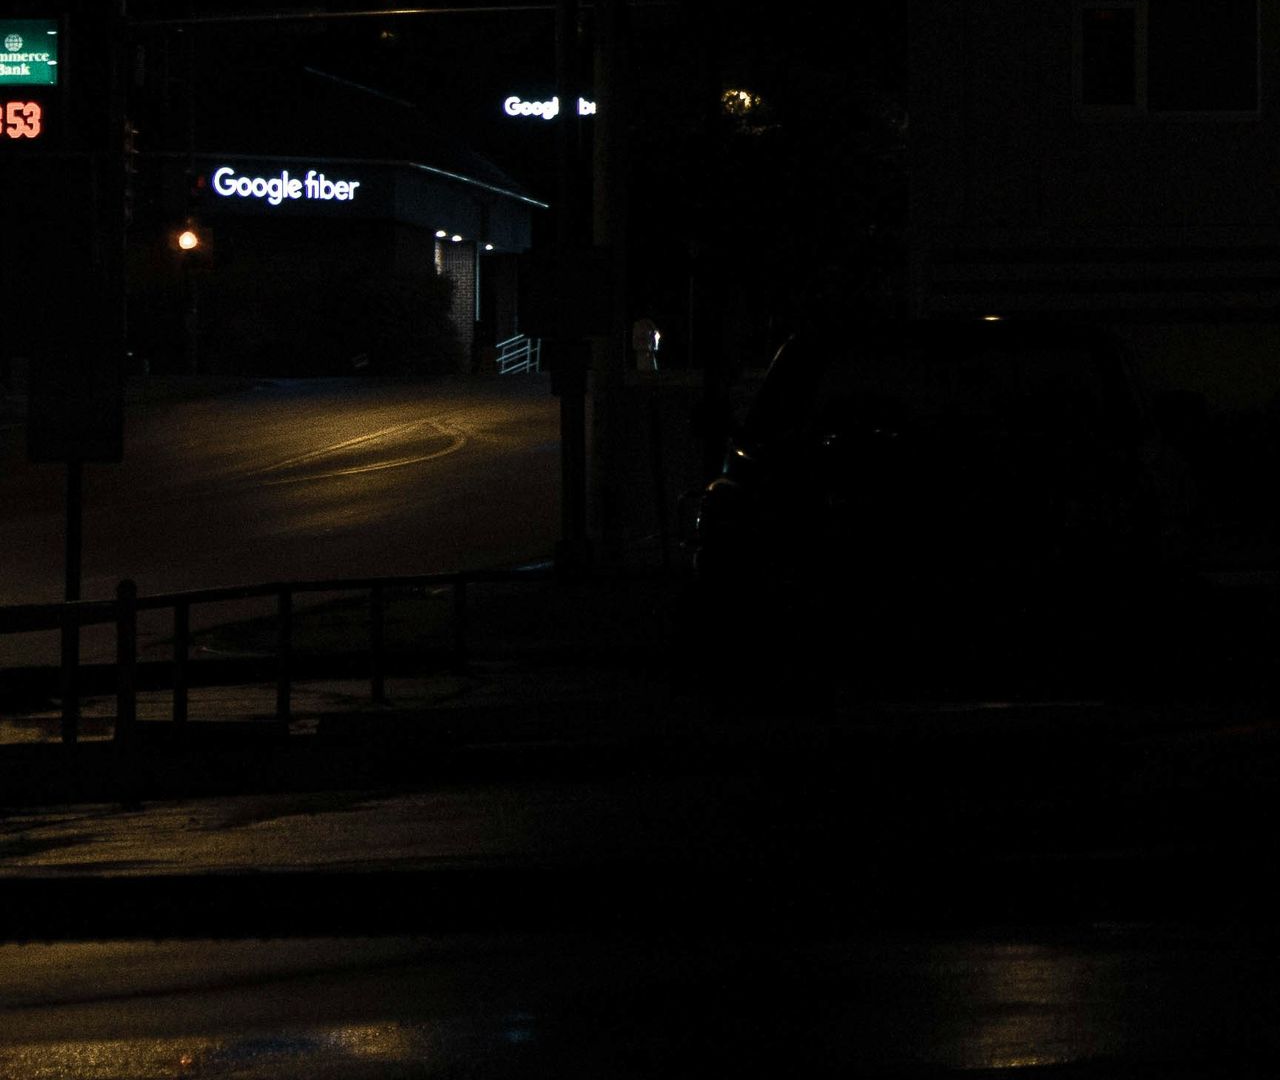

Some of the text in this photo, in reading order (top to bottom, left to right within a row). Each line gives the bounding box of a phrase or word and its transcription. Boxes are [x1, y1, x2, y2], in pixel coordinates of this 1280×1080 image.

[0, 102, 41, 138] 53
[504, 96, 559, 120] Googl
[213, 167, 360, 205] Google fiber
